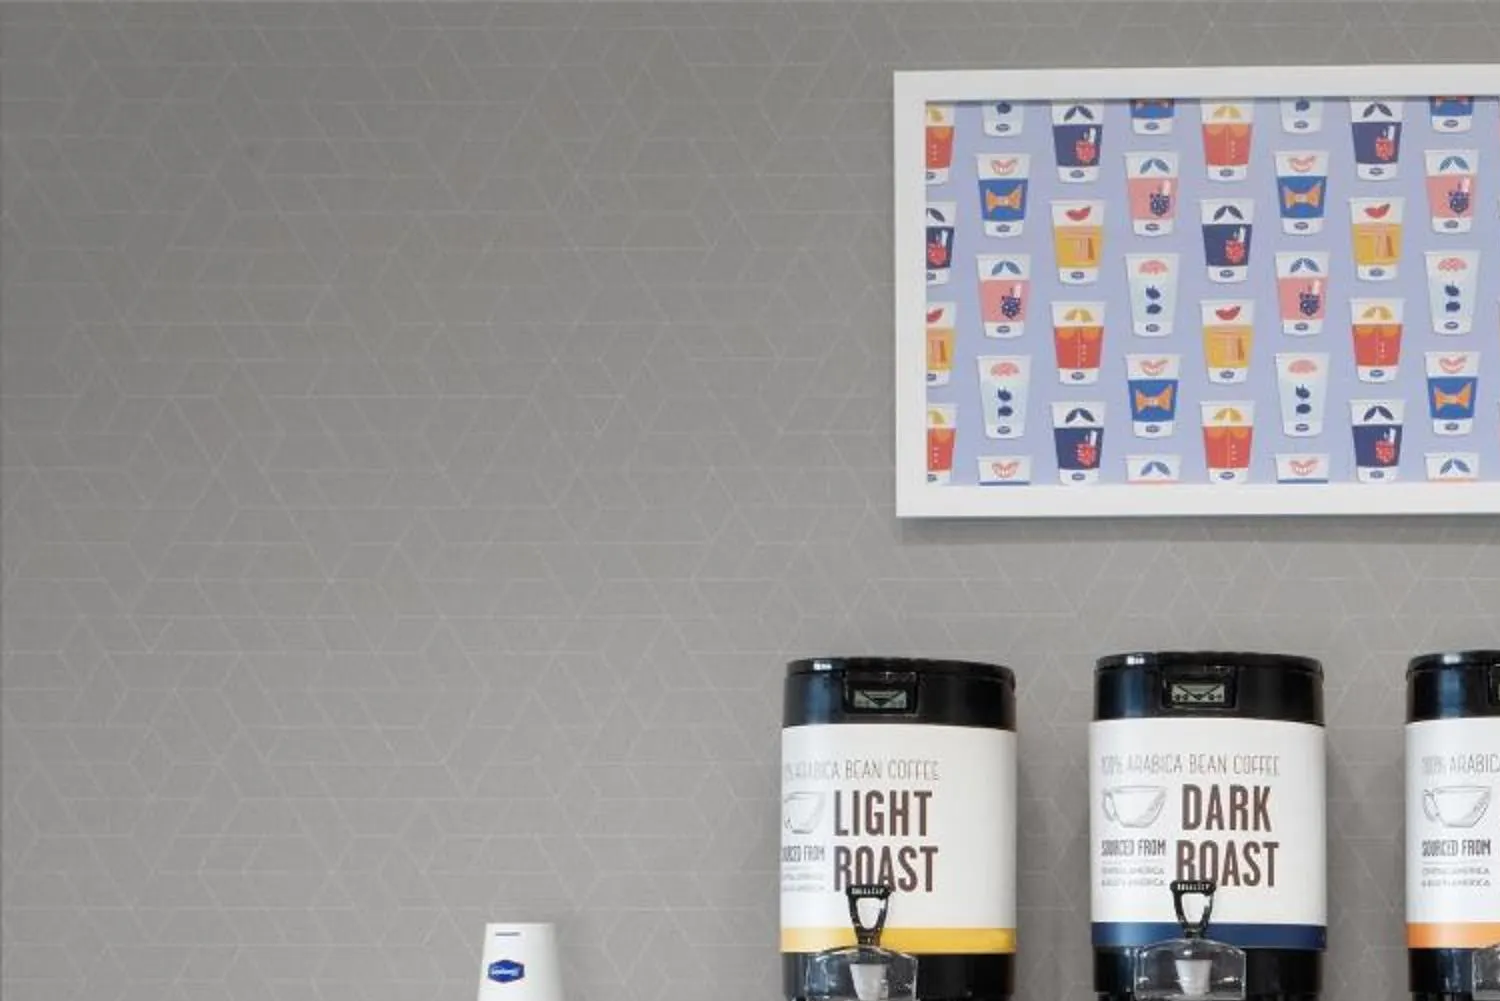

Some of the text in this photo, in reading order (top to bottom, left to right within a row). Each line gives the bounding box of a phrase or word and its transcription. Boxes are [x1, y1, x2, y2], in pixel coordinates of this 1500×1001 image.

[845, 759, 882, 779] BEAN
[888, 759, 939, 781] COFFEE
[1189, 753, 1227, 775] BEAN
[1233, 755, 1280, 777] COFFEE
[834, 790, 933, 836] LIGHT
[1181, 784, 1272, 832] DARK
[834, 846, 938, 892] ROAST
[1176, 840, 1279, 887] ROAST
